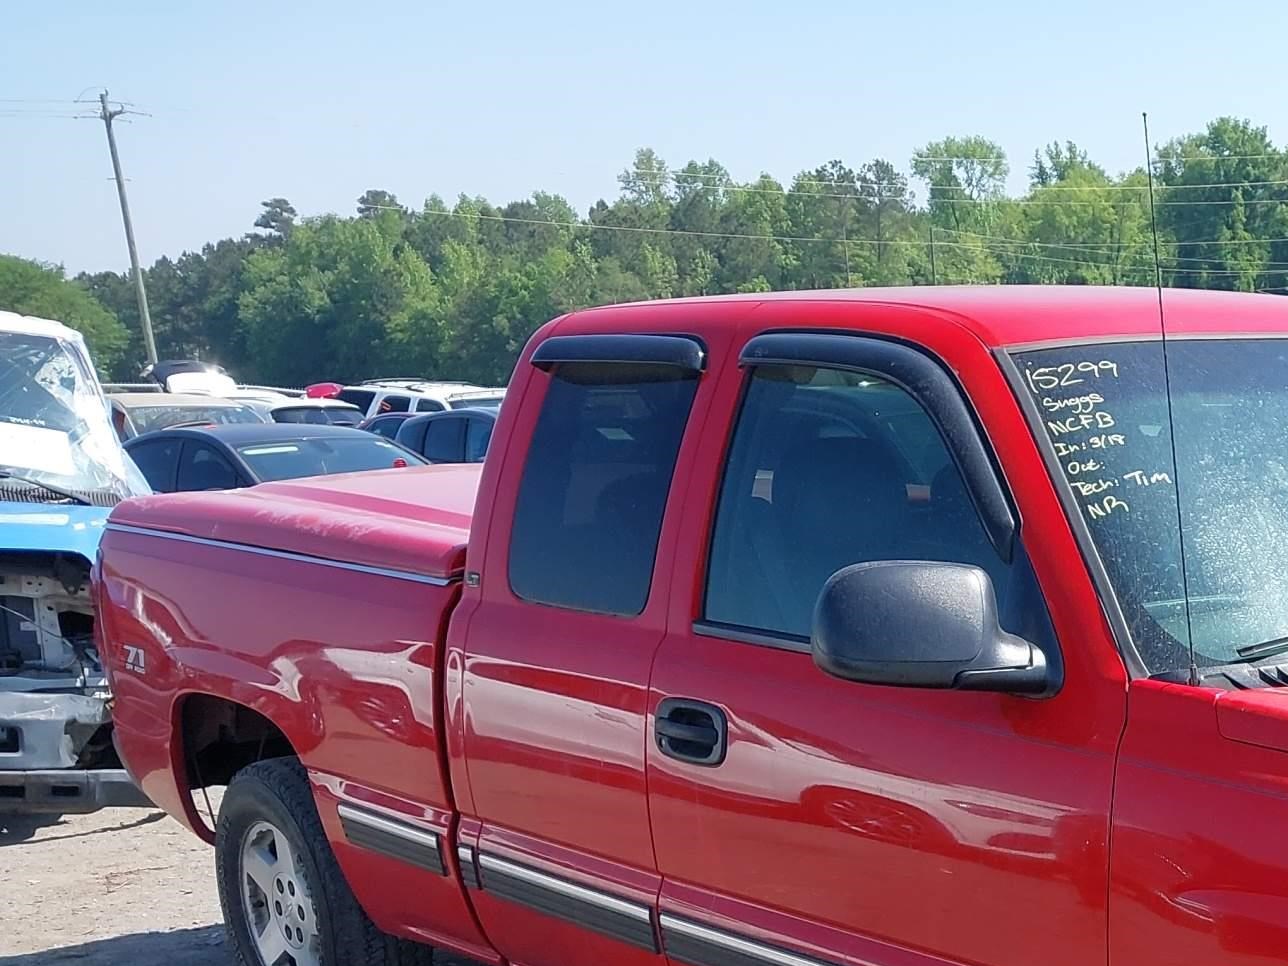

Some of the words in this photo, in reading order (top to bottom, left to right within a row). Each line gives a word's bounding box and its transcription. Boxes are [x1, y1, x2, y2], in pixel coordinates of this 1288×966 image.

[1043, 393, 1104, 413] Suggs
[1048, 412, 1115, 435] NCFB
[1054, 442, 1087, 456] In:
[1070, 479, 1120, 496] Tech:
[1123, 470, 1172, 487] Tim
[1087, 495, 1129, 519] NR
